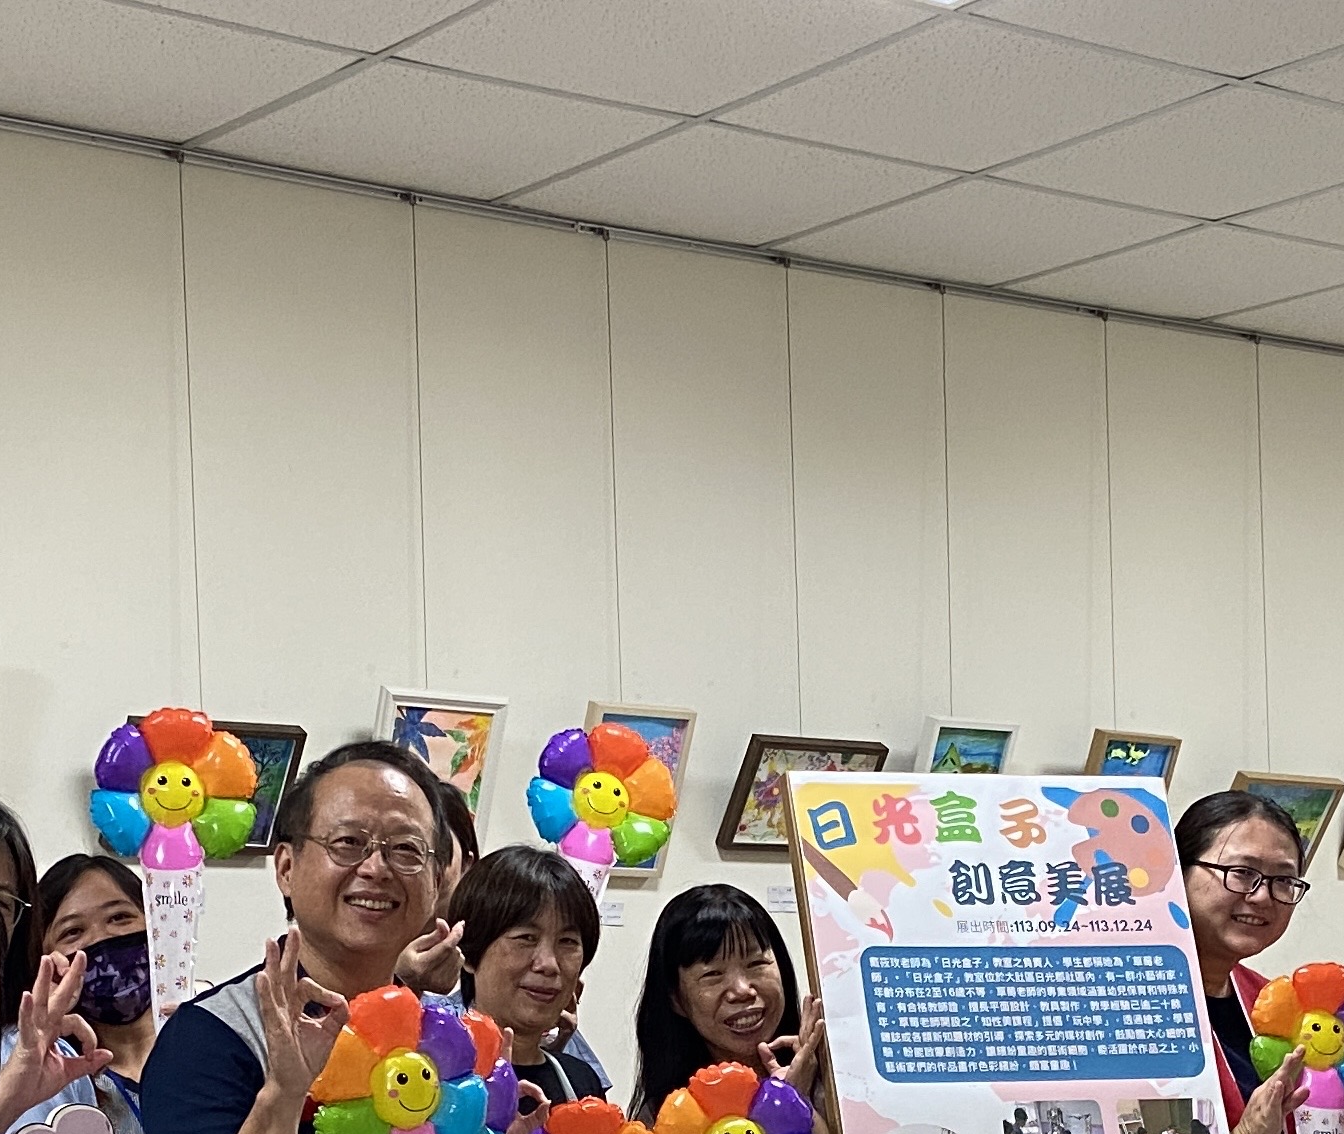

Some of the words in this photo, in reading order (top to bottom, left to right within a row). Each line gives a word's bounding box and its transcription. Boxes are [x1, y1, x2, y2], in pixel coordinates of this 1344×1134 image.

[807, 791, 1047, 850] 日光盒子
[155, 891, 188, 908] smile
[948, 859, 1136, 906] 創意美展
